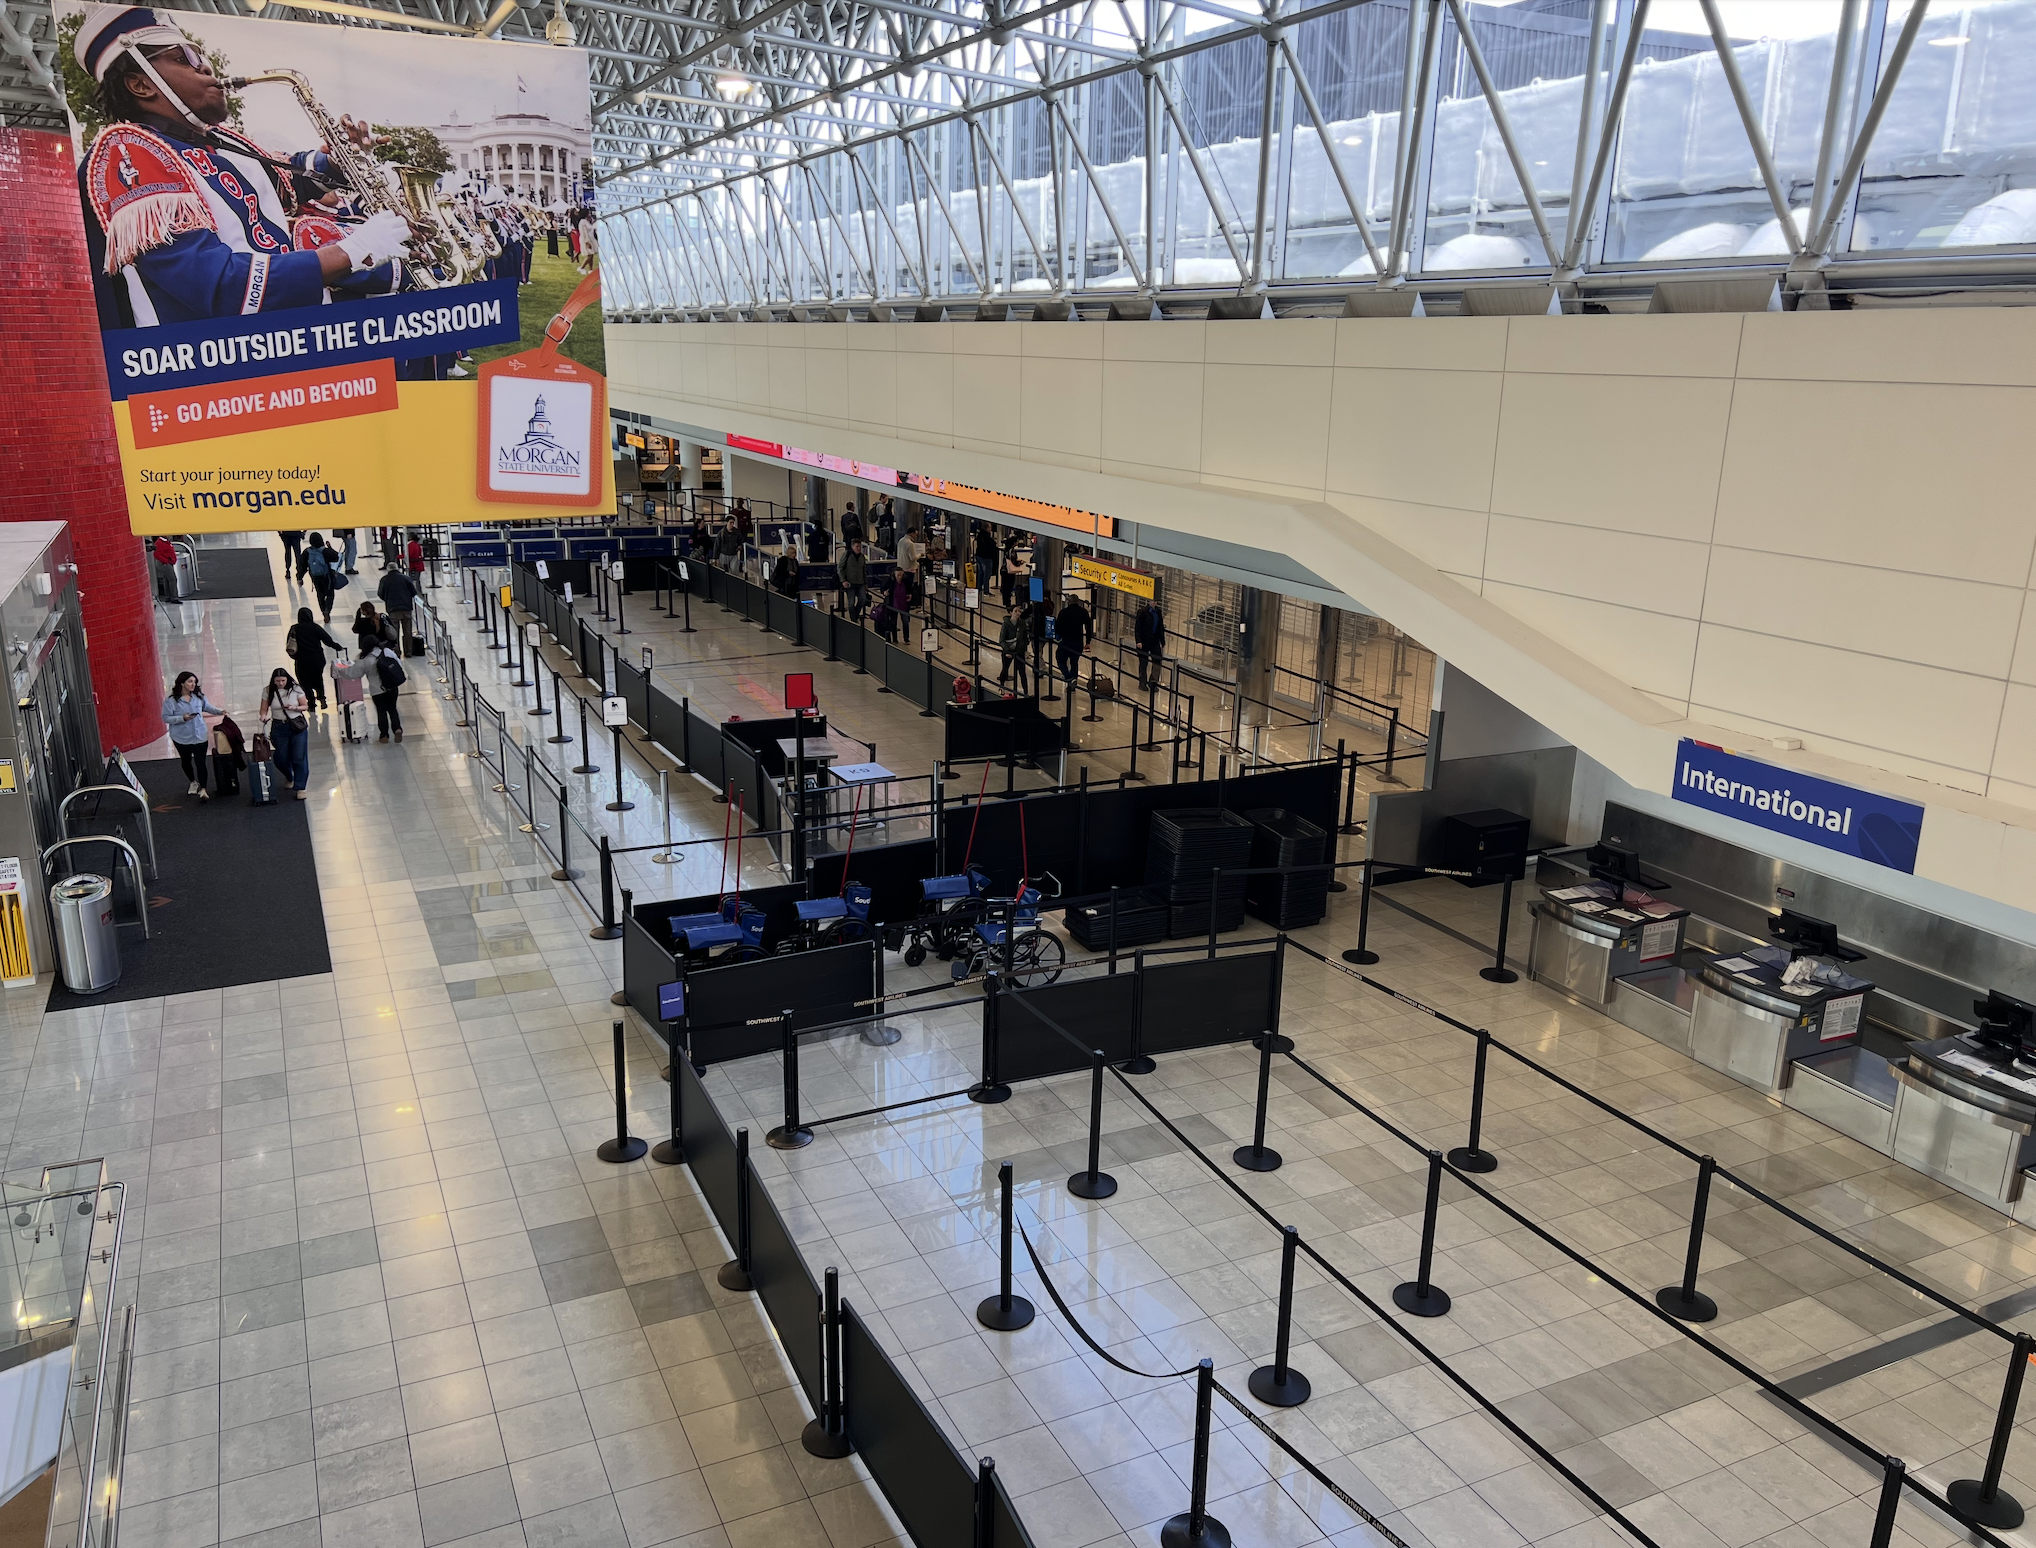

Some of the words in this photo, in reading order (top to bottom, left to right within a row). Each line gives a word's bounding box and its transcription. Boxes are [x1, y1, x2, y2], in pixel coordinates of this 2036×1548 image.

[248, 260, 266, 308] MORGAN
[122, 341, 197, 378] SOAR
[200, 328, 308, 365] OUTSIDE
[310, 321, 358, 353] THE
[363, 299, 502, 345] CLASSROOM
[176, 402, 202, 424] GO
[206, 392, 264, 420] ABOVE
[268, 388, 306, 411] AND
[308, 376, 377, 405] BEYOND
[498, 446, 580, 466] MORGAN
[498, 462, 524, 471] STATE
[140, 468, 177, 483] Start
[180, 469, 215, 486] your
[217, 467, 274, 484] journey
[277, 464, 321, 483] today!
[143, 494, 187, 510] Visit
[192, 484, 346, 514] morgan.edu
[1080, 564, 1102, 582] Security
[1102, 571, 1107, 581] C
[1681, 761, 1852, 836] International
[1424, 867, 1452, 876] SOUTHWEST
[954, 976, 983, 987] SOUTHWEST
[854, 997, 884, 1008] SOUTHWEST
[884, 992, 907, 1002] AIRLINES
[1394, 992, 1418, 1007] SOUTHWEST
[1418, 1003, 1436, 1016] AIRLINES
[746, 1016, 780, 1026] SOUTHWEST
[1214, 1384, 1250, 1419] SOUTHWEST
[1250, 1414, 1278, 1441] AIRLINES
[1330, 1483, 1372, 1524] SOUTHWEST
